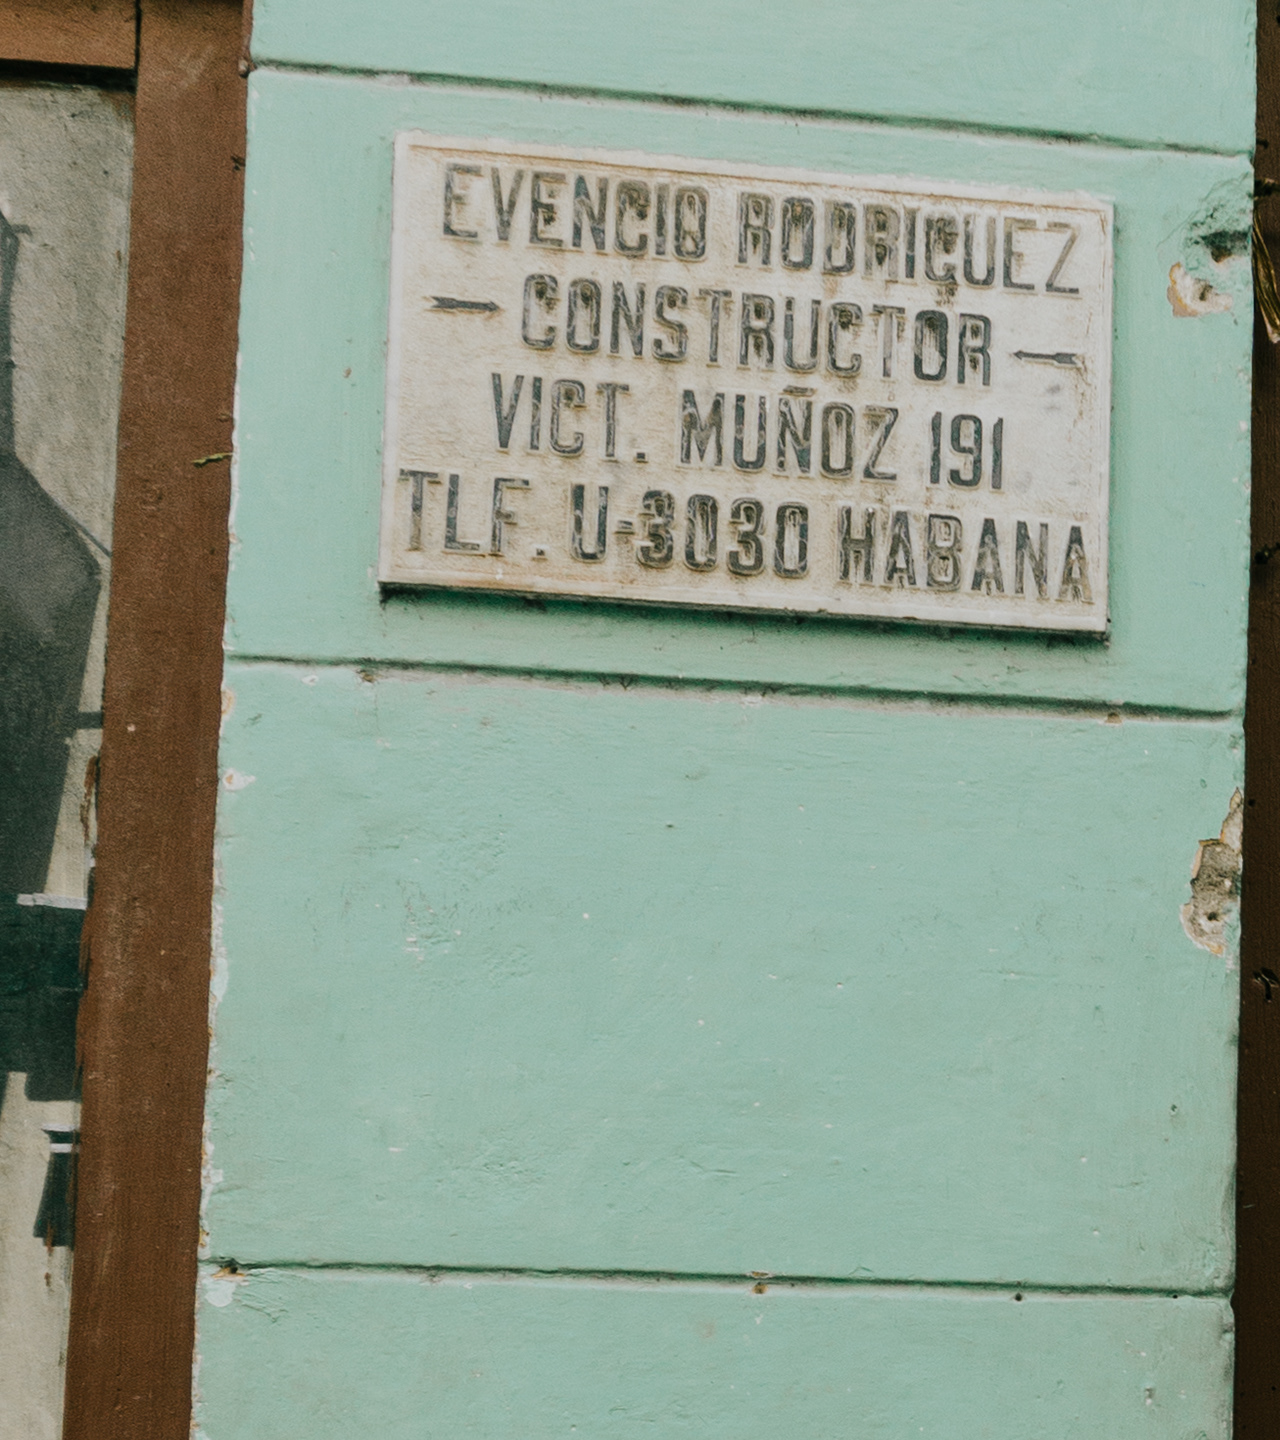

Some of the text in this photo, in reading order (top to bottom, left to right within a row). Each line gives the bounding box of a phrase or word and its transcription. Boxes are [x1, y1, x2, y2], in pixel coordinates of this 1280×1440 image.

[442, 162, 1081, 295] EVENCIO RODRIGUEZ
[521, 272, 992, 387] CONSTRUCTOR
[491, 372, 1004, 491] VICT. MUÑOZ 191
[399, 467, 1094, 603] TLF. U-3030 HABANA
